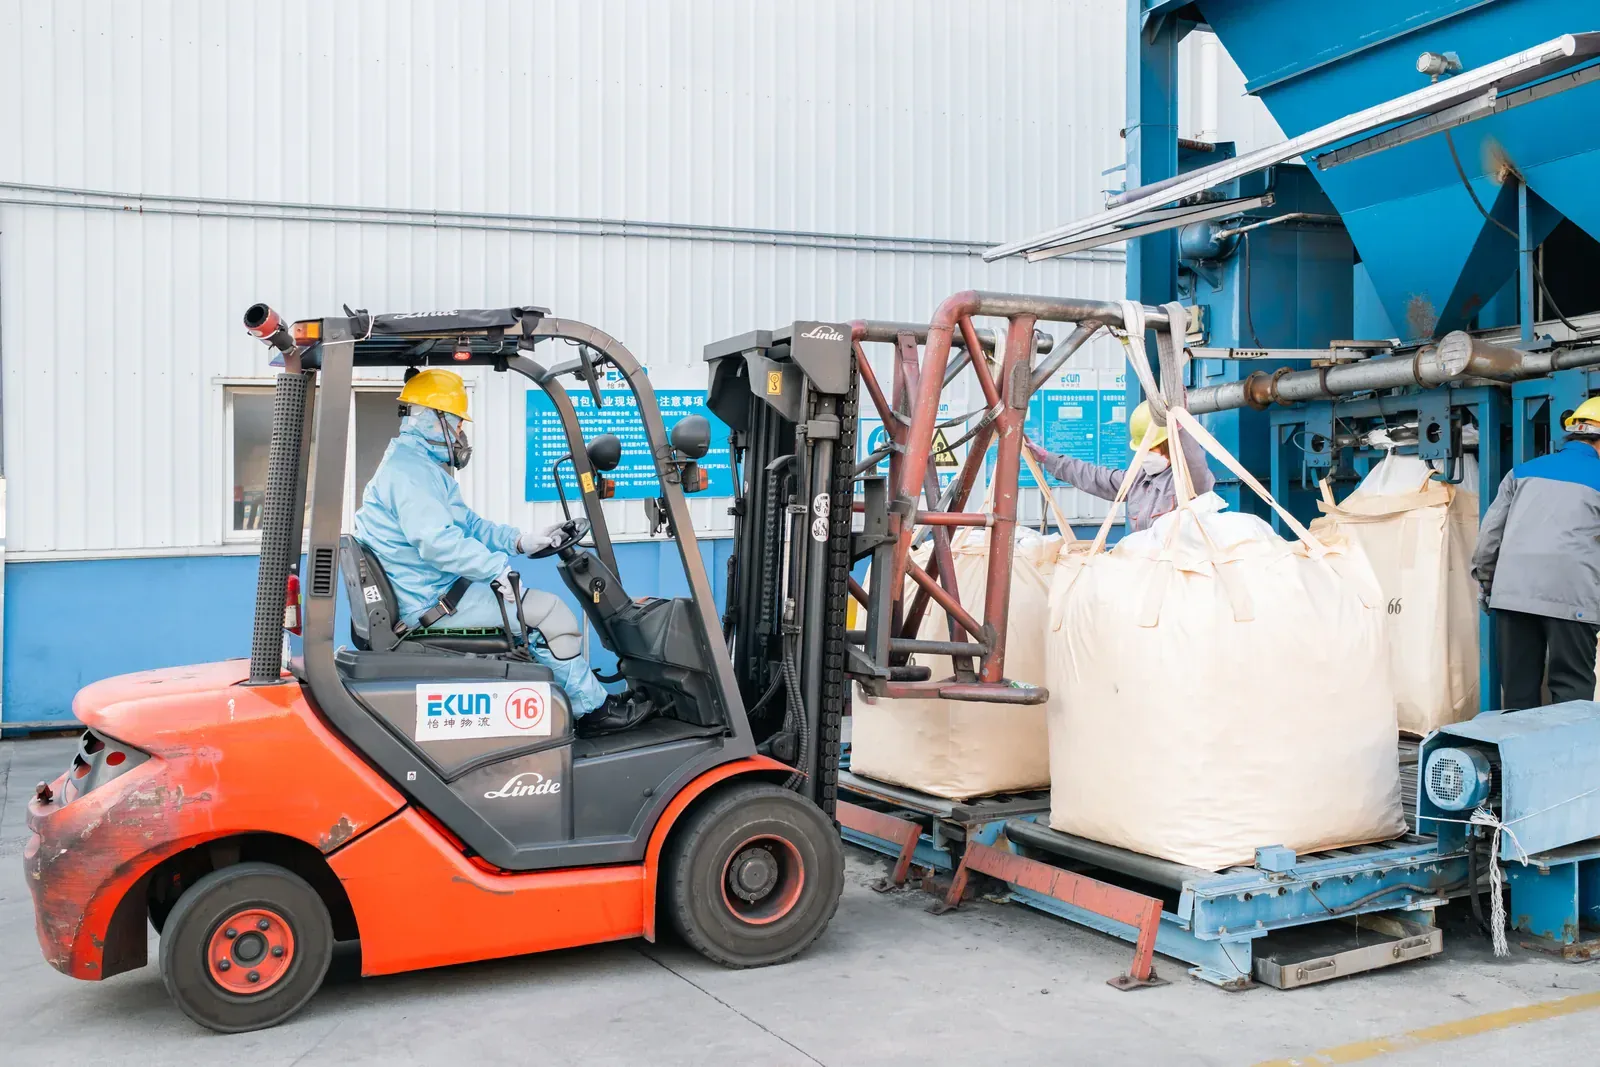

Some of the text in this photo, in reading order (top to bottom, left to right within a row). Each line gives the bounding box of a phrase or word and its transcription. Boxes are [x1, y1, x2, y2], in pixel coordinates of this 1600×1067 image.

[801, 325, 844, 341] Linde
[1387, 597, 1403, 615] 66
[511, 697, 538, 719] 16
[427, 717, 491, 729] 怡坤物流
[484, 772, 561, 799] Linde
